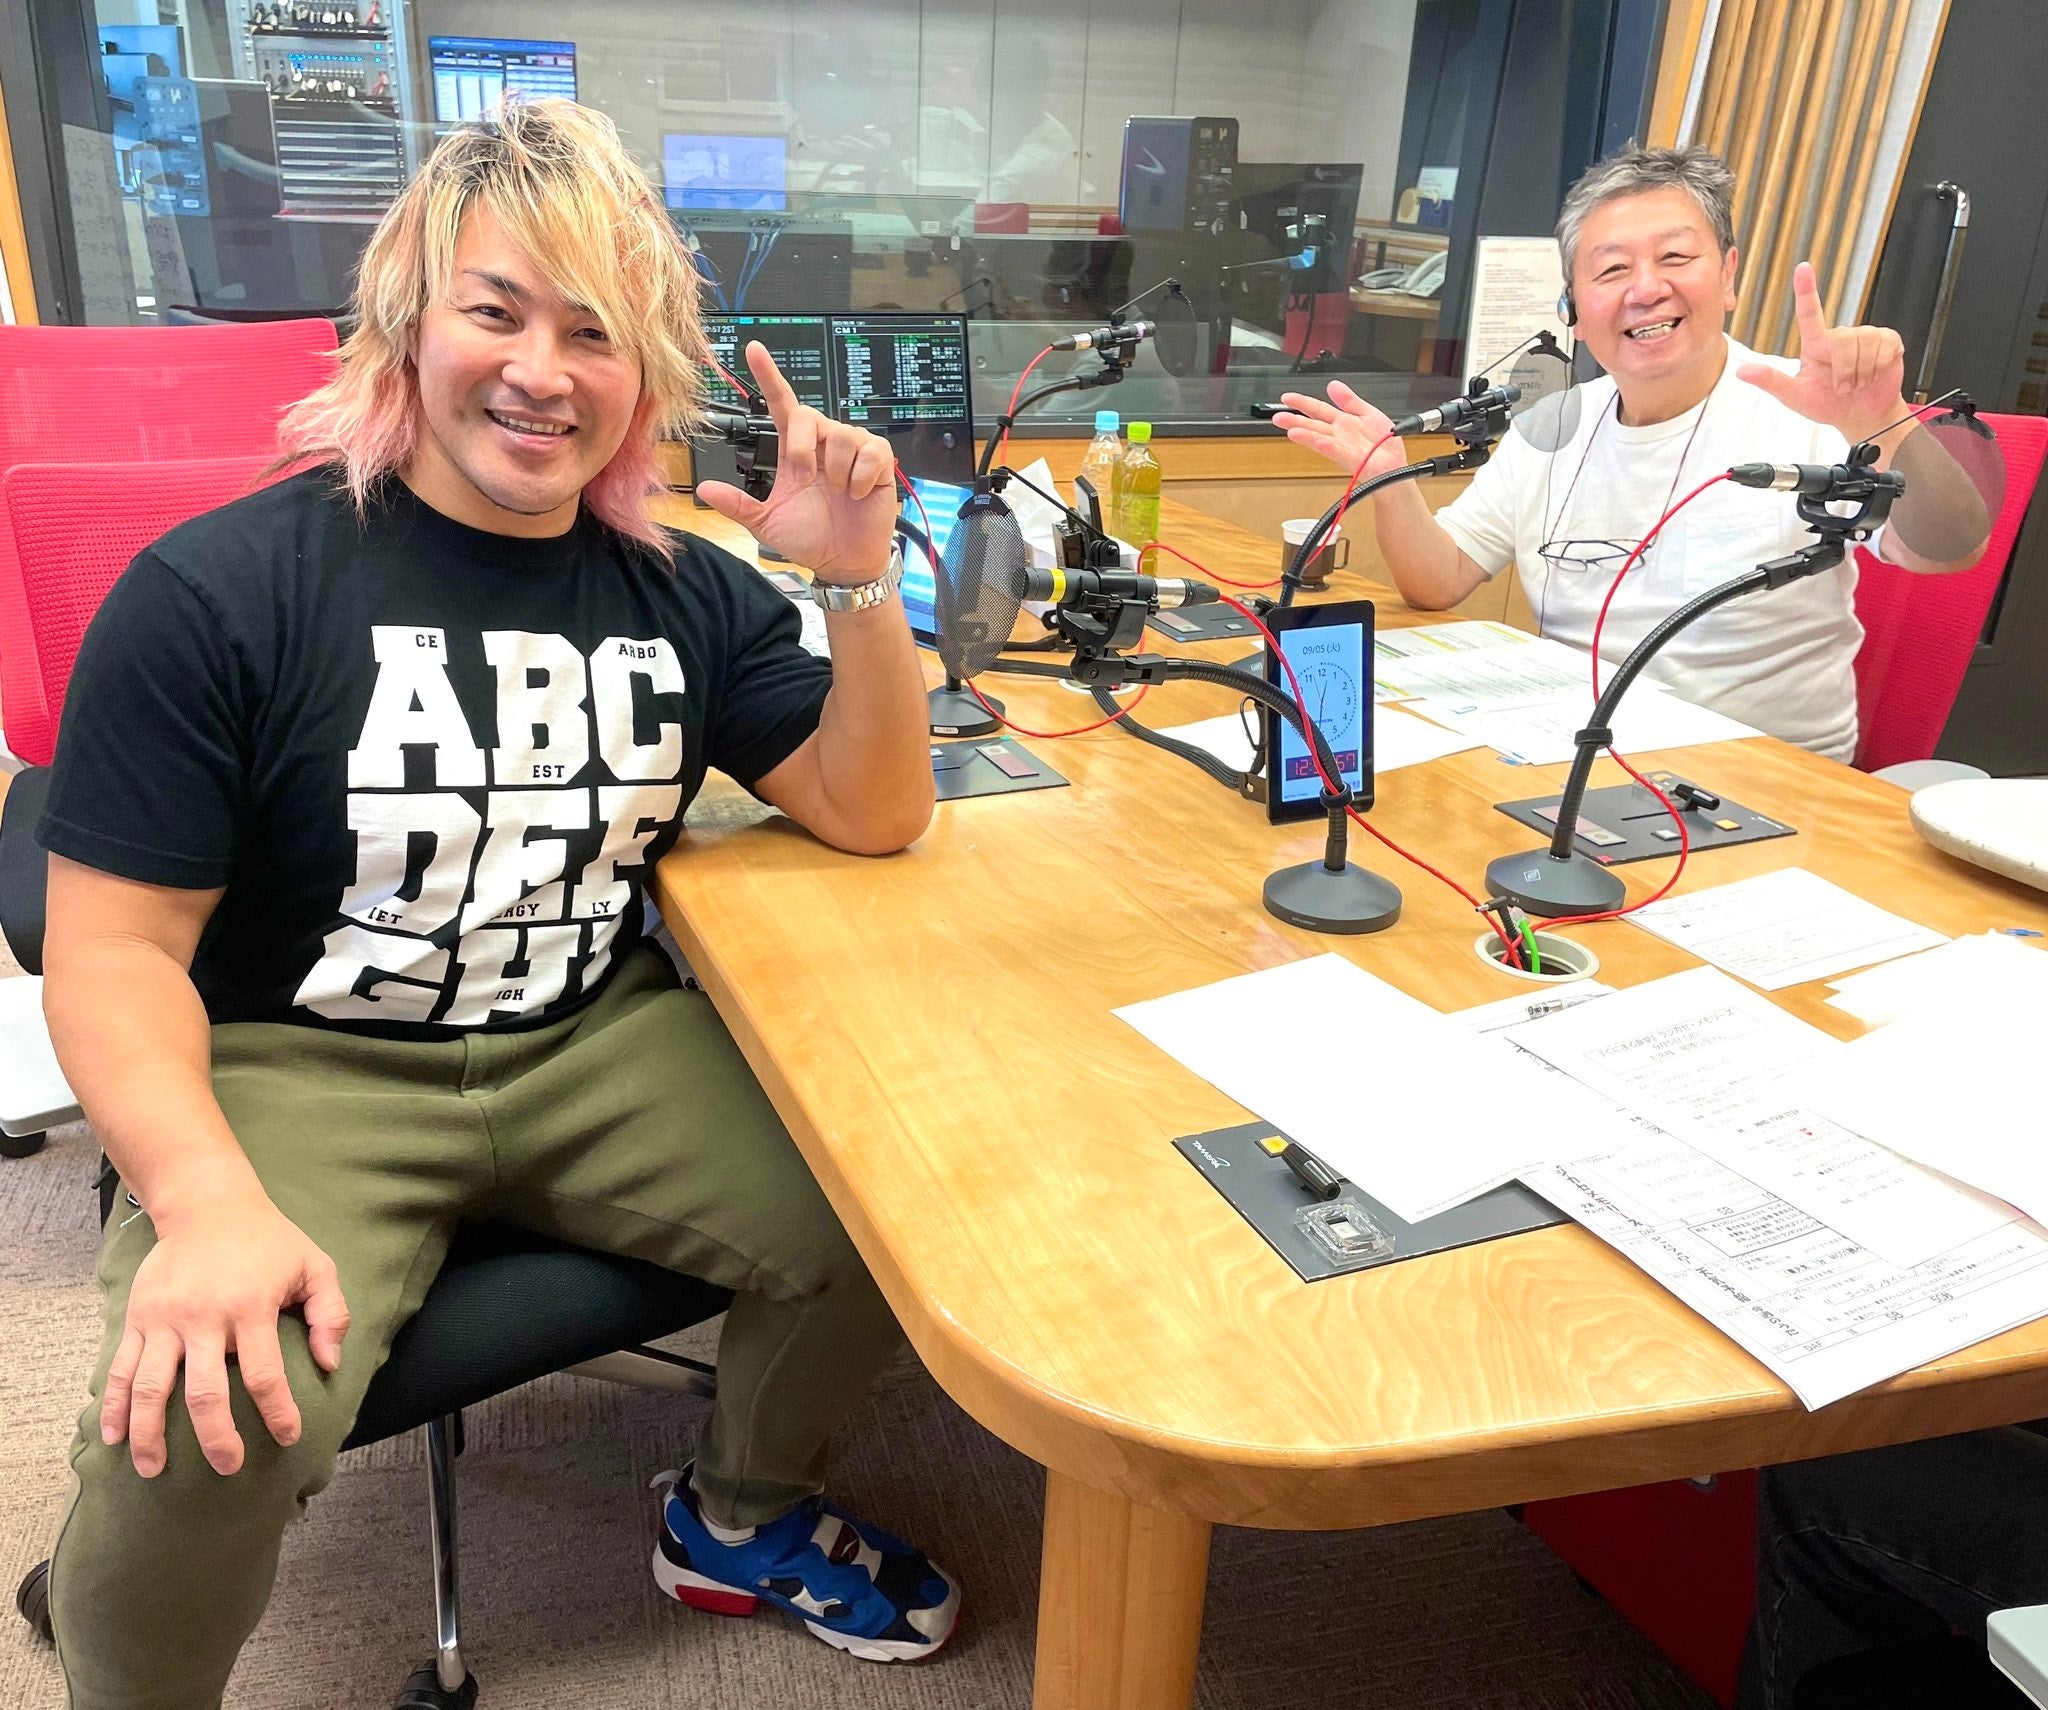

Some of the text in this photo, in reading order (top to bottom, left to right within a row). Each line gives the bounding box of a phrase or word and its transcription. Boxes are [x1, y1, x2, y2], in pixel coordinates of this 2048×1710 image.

[414, 633, 439, 649] CE
[617, 642, 657, 659] ARBO
[1302, 644, 1326, 655] 09/05
[1317, 668, 1327, 677] 12
[1305, 674, 1313, 683] 11
[1342, 681, 1348, 690] 2
[1345, 696, 1351, 705] 3
[1342, 712, 1348, 721] 4
[1332, 725, 1338, 734] 5
[532, 764, 566, 779] EST
[591, 900, 611, 915] LY
[368, 905, 403, 925] IET
[494, 987, 525, 1002] IGH
